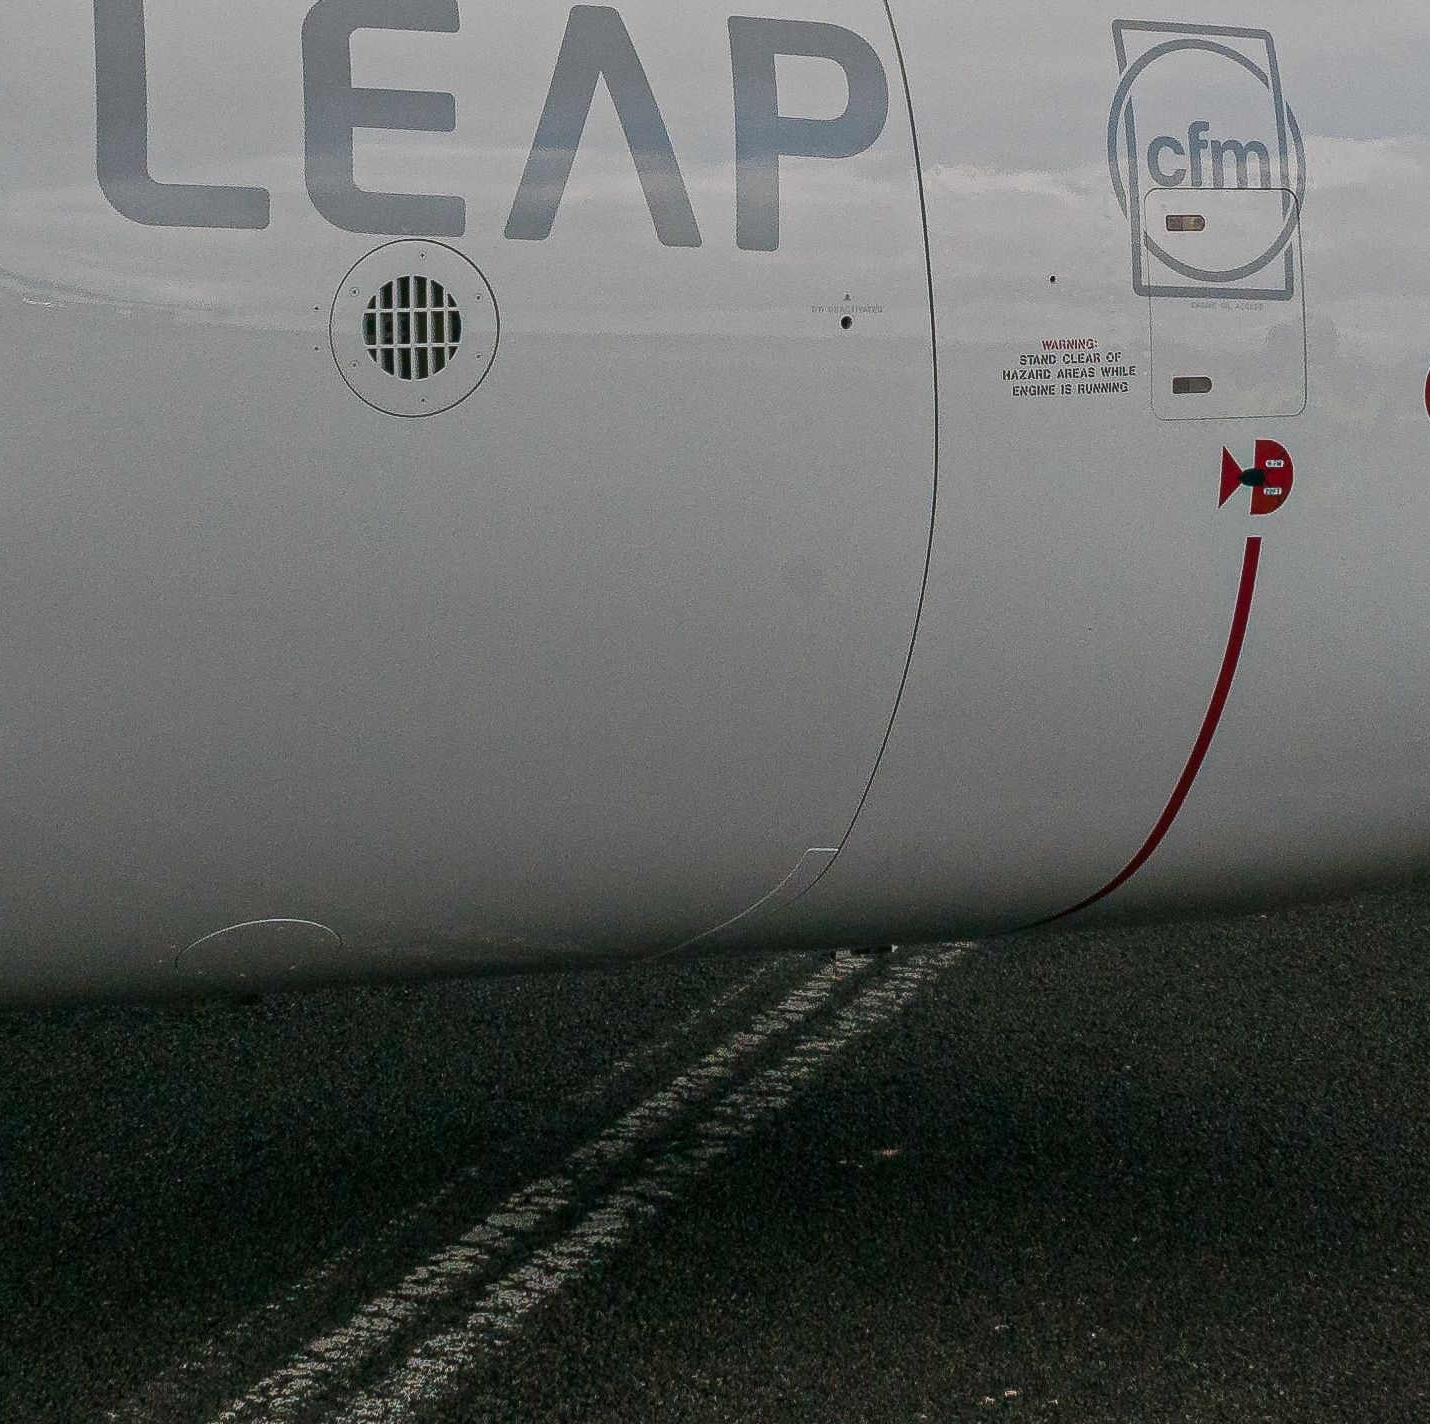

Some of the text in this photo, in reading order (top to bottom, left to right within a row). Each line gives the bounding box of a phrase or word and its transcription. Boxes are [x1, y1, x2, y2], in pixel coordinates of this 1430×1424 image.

[1147, 120, 1271, 189] cfm
[1042, 339, 1098, 350] WARNING:
[1019, 352, 1122, 365] STAND CLEAR OF
[1002, 365, 1136, 380] HAZARD AREAS WHILE
[1012, 381, 1128, 396] ENGINE IS RUNNING
